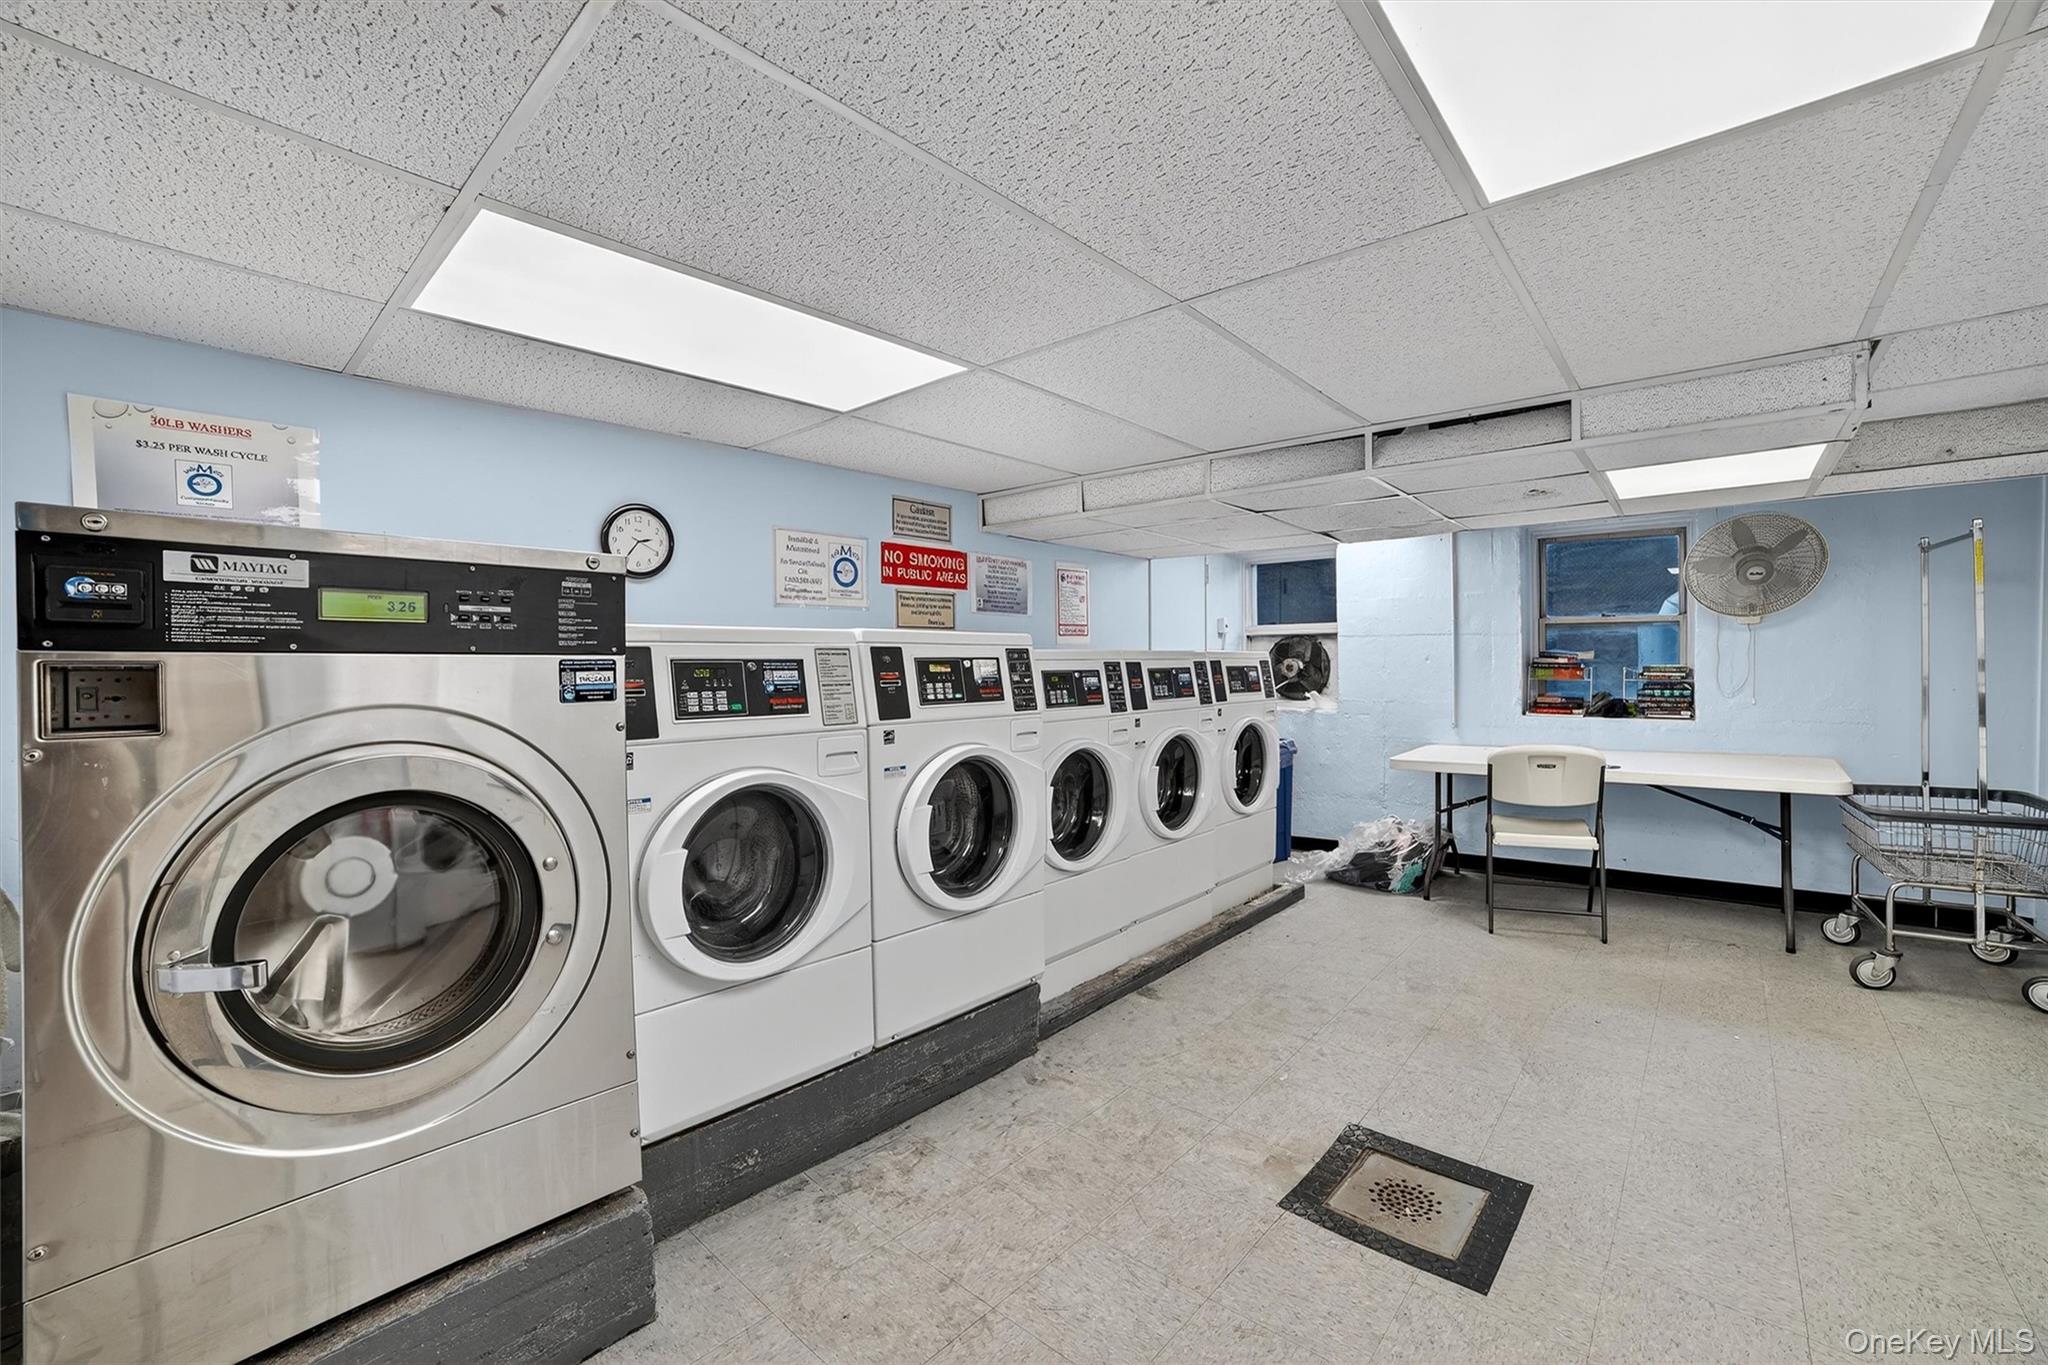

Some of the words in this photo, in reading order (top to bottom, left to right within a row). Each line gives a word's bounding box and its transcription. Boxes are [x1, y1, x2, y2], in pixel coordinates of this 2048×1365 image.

[150, 415, 185, 429] 30LB
[187, 421, 252, 439] WASHERS
[135, 439, 166, 451] $3.25
[168, 444, 192, 454] PER
[194, 446, 229, 458] WASH
[230, 451, 269, 463] CYCLE
[222, 560, 288, 575] MAYTAG
[883, 549, 904, 564] NO
[909, 552, 965, 571] SMOKING
[881, 566, 893, 578] IN
[897, 567, 933, 582] PUBLIC
[936, 571, 967, 584] AREAS
